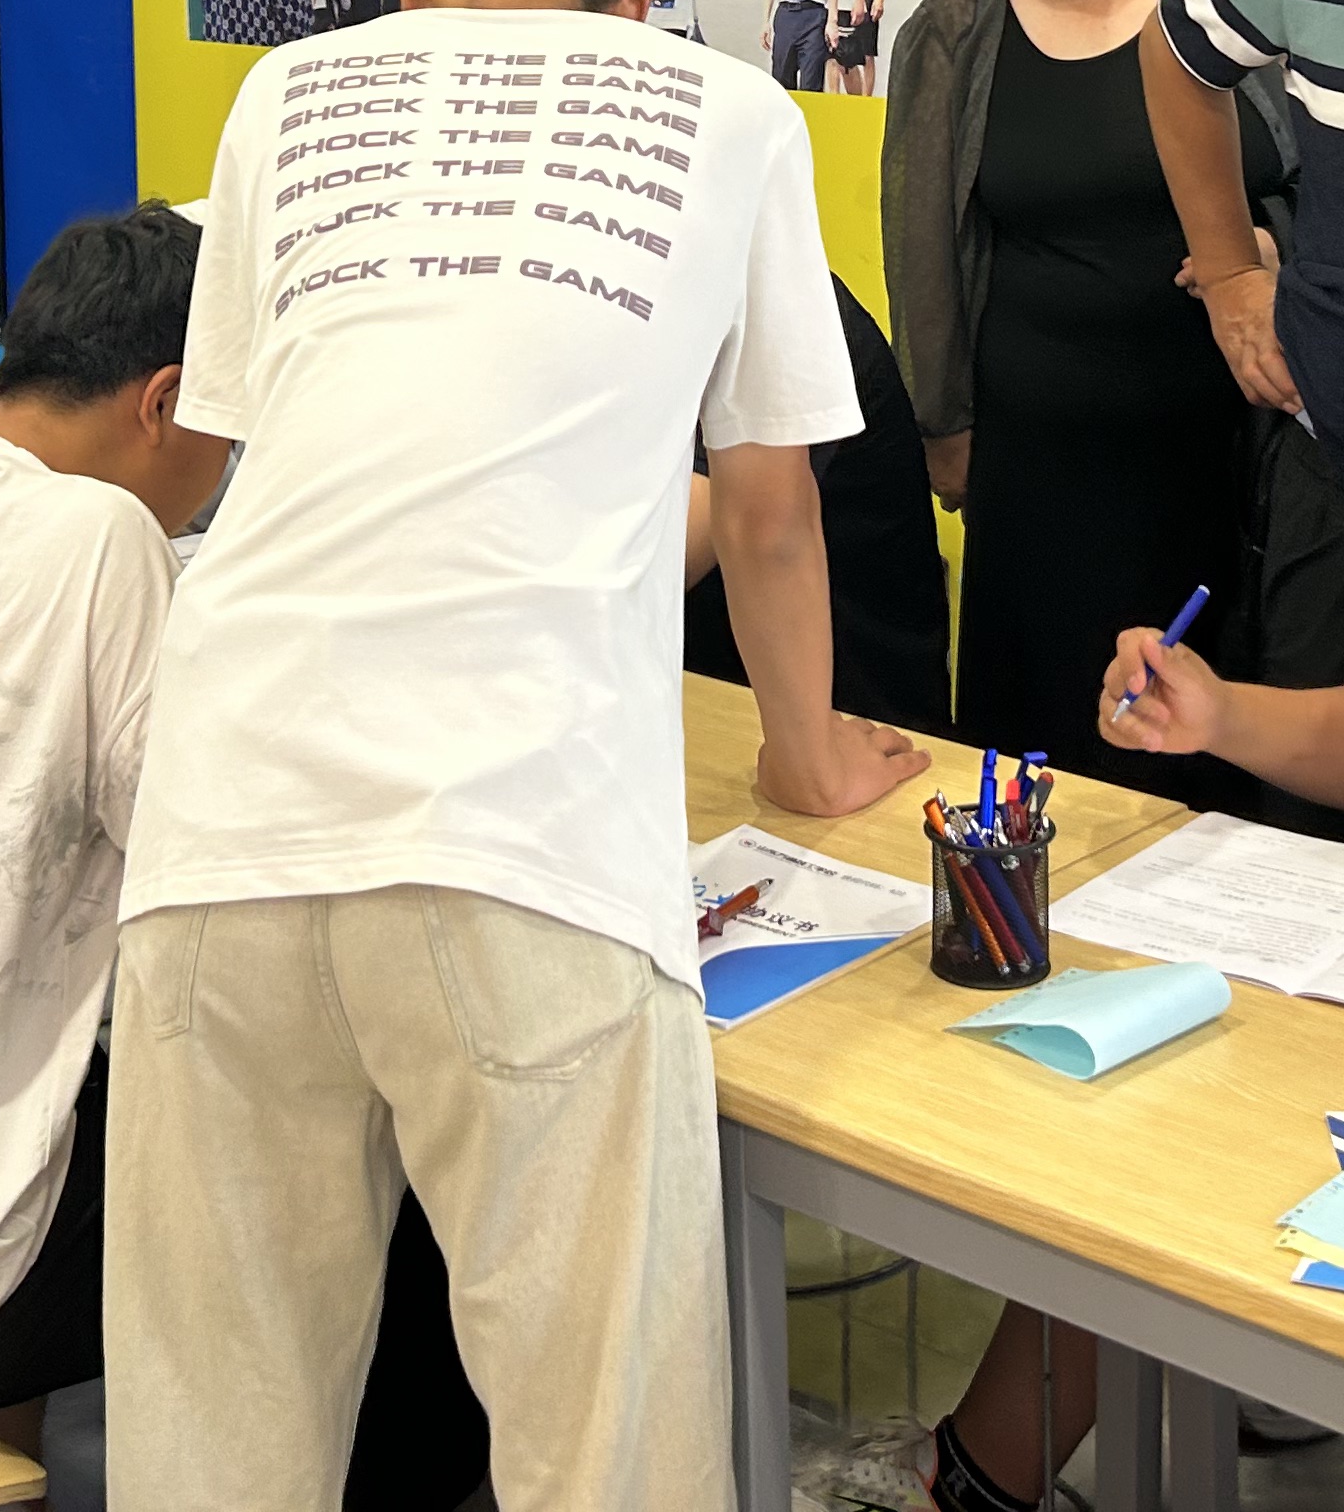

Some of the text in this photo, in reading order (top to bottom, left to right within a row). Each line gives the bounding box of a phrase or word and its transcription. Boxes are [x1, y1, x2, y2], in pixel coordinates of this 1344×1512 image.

[284, 72, 702, 108] SHOCK THE GAME
[288, 52, 704, 87] SHOCK THE GAME
[280, 98, 698, 138] SHOCK THE GAME
[277, 129, 690, 173] SHOCK THE GAME
[275, 160, 684, 212] SHOCK THE GAME
[423, 201, 516, 216] THE
[535, 202, 672, 259] GAME
[410, 256, 501, 277] THE
[519, 258, 654, 322] GAME
